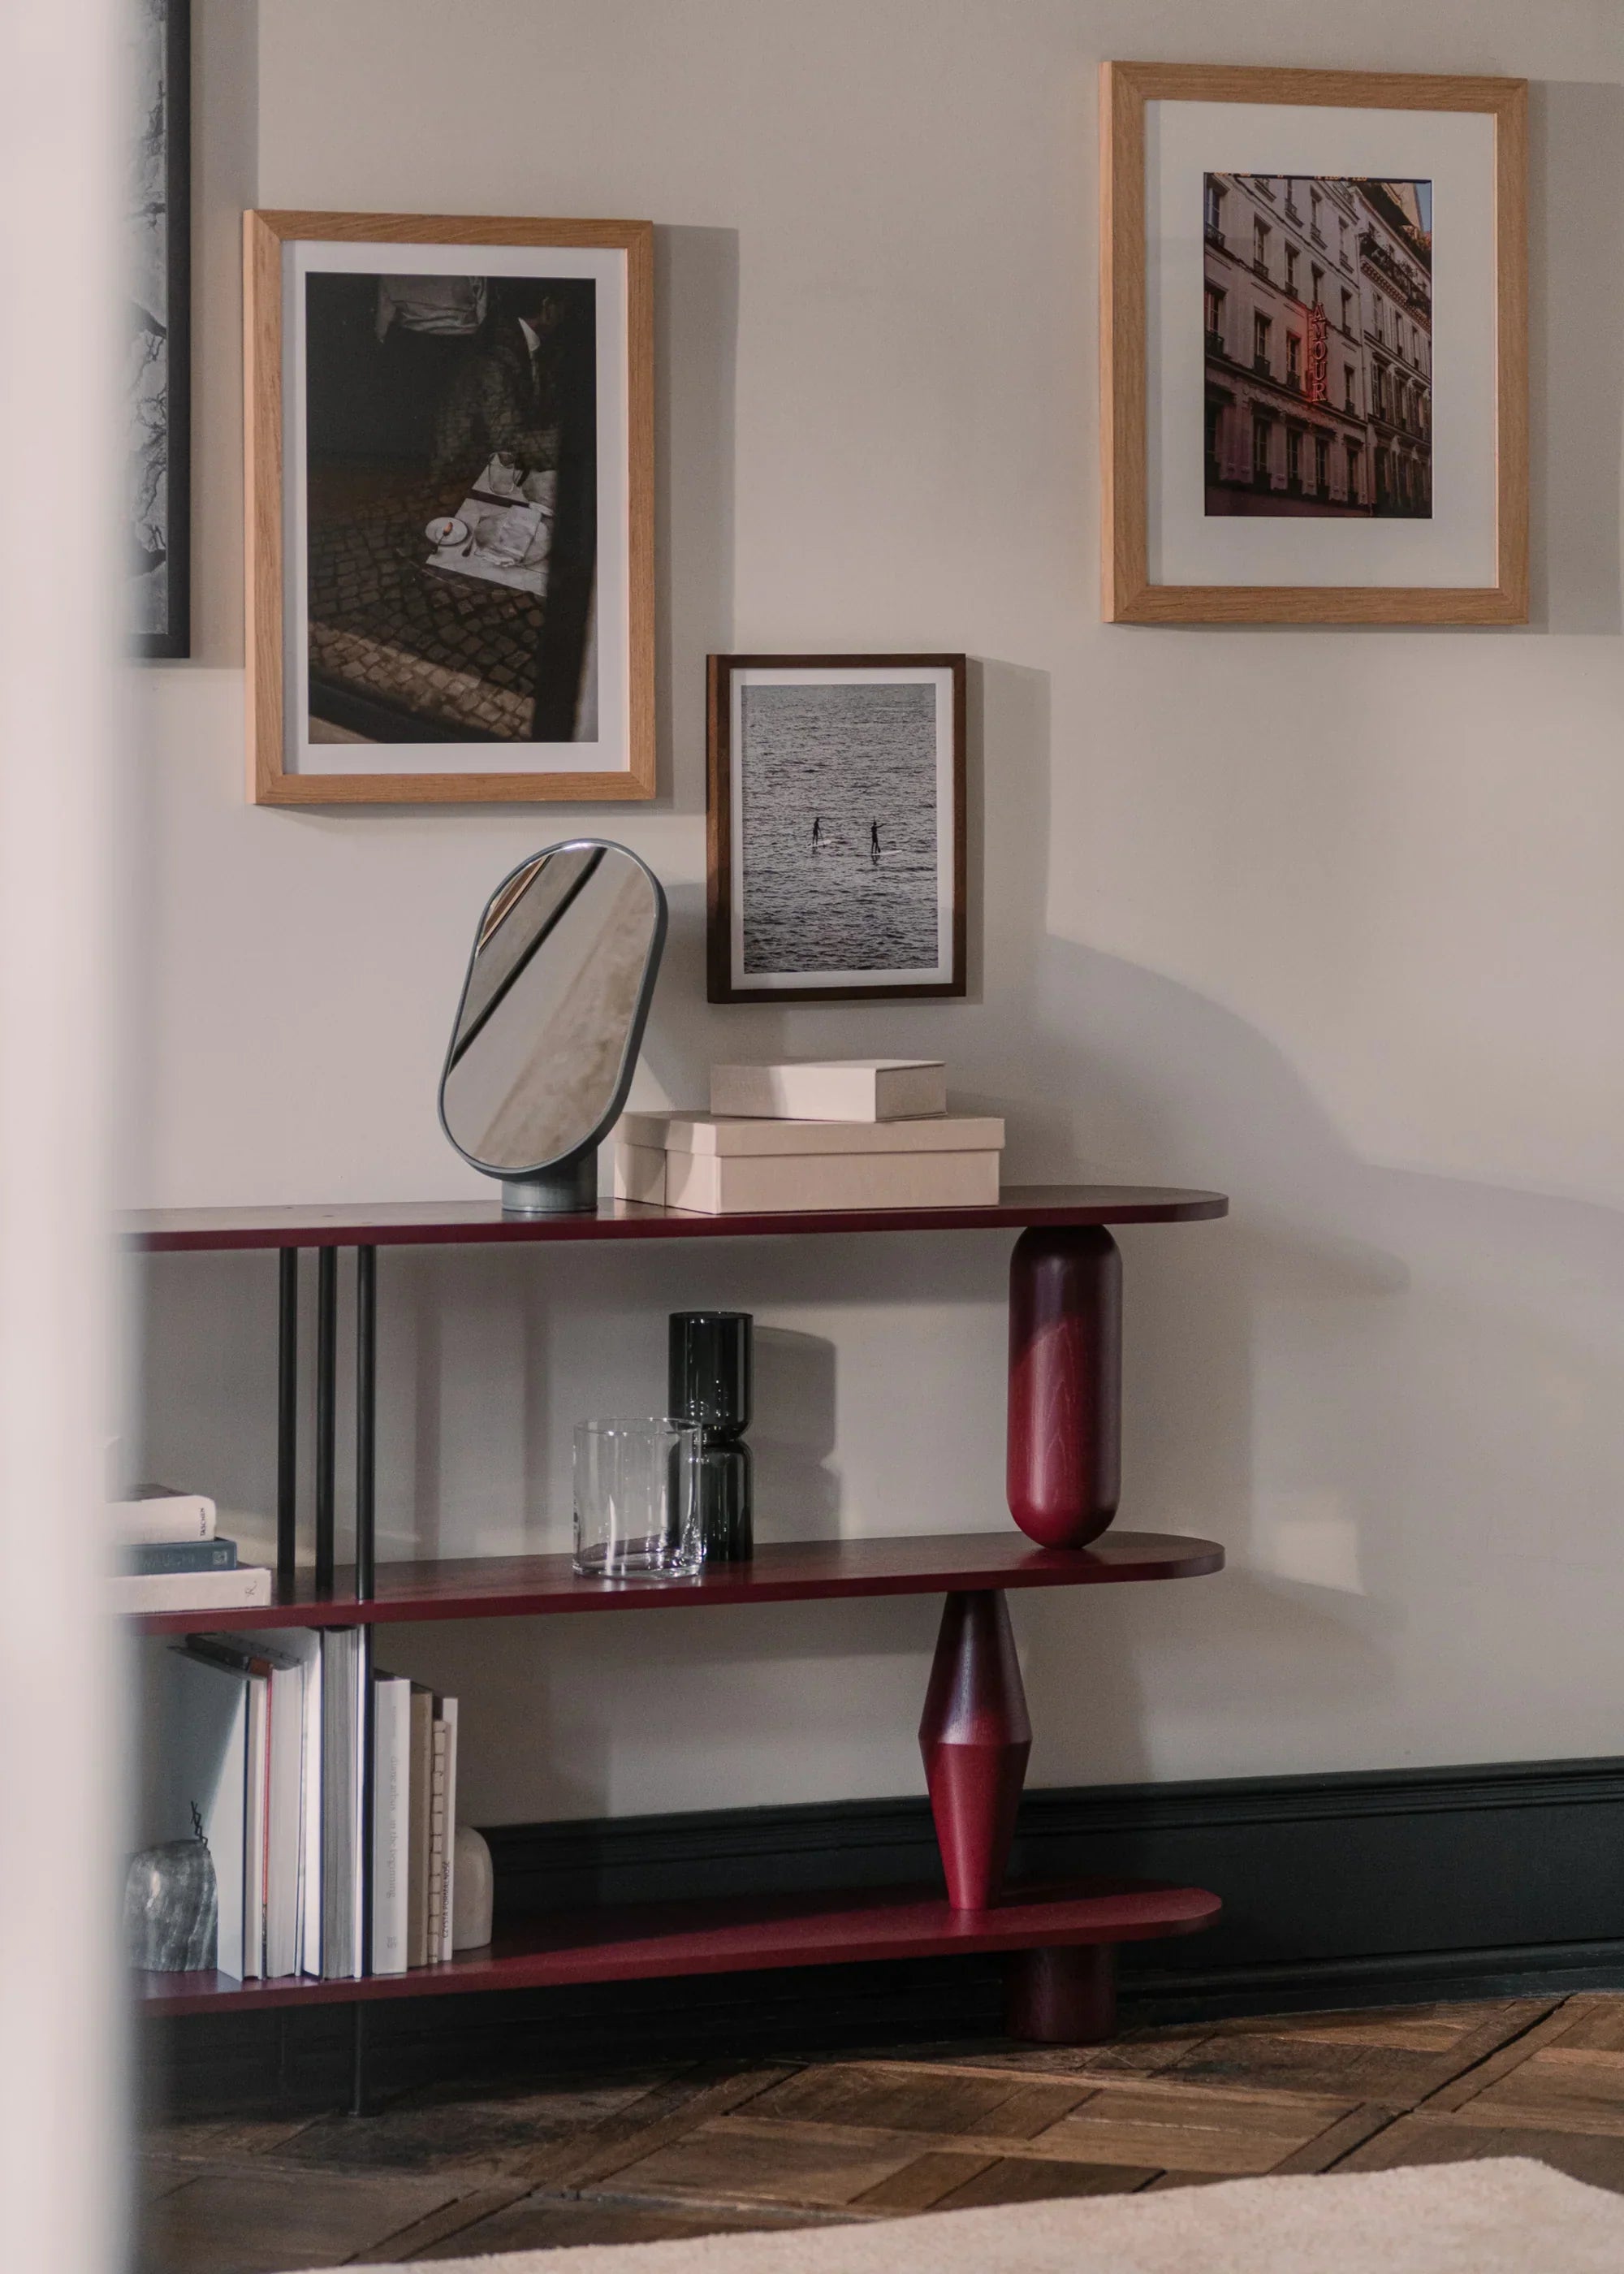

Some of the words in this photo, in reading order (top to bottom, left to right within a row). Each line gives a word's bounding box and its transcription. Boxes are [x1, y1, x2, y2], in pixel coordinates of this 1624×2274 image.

[1311, 302, 1328, 402] AMOUR
[390, 1756, 400, 1783] diane
[389, 1831, 398, 1846] the
[387, 1849, 398, 1899] beginning
